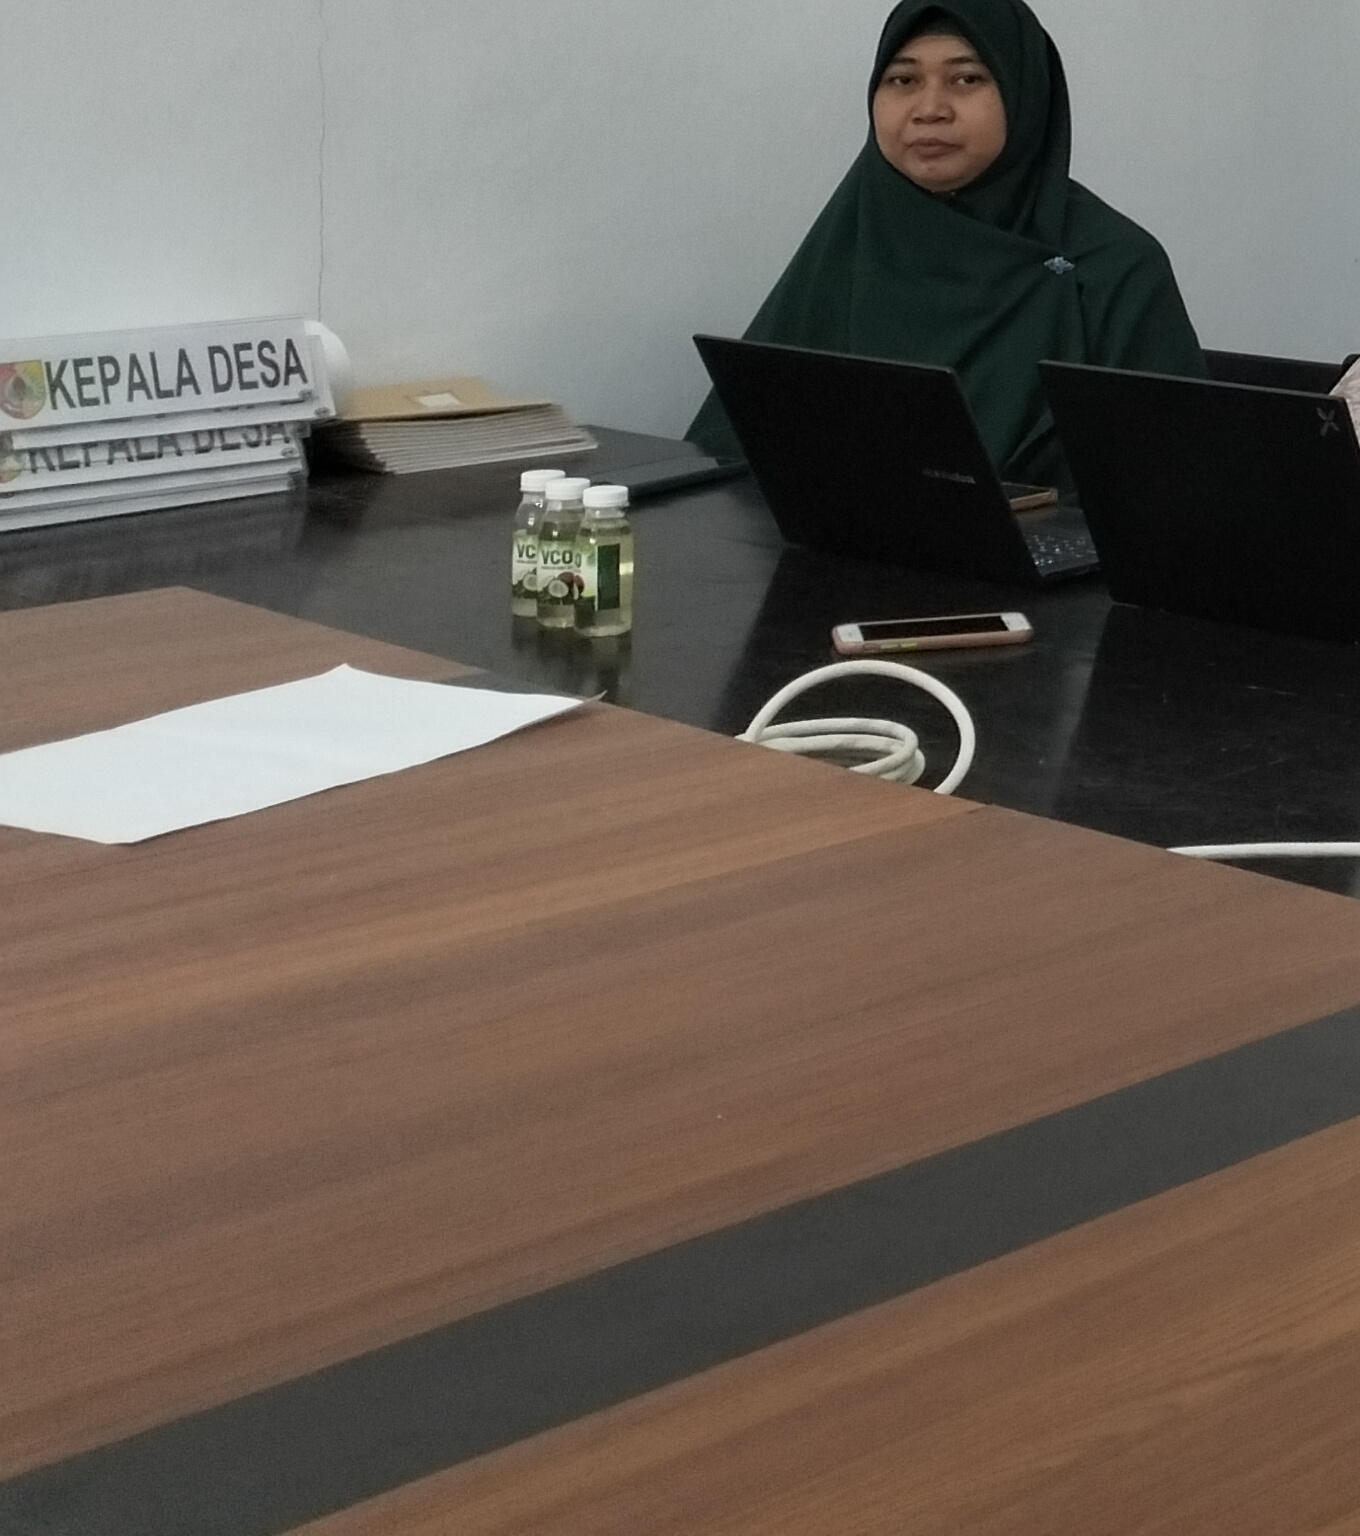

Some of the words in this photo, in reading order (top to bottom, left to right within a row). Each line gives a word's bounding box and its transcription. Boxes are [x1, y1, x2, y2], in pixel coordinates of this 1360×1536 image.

[45, 348, 202, 411] KEPALA
[207, 338, 308, 394] DESA
[516, 544, 537, 560] VC
[541, 549, 574, 566] VCO
